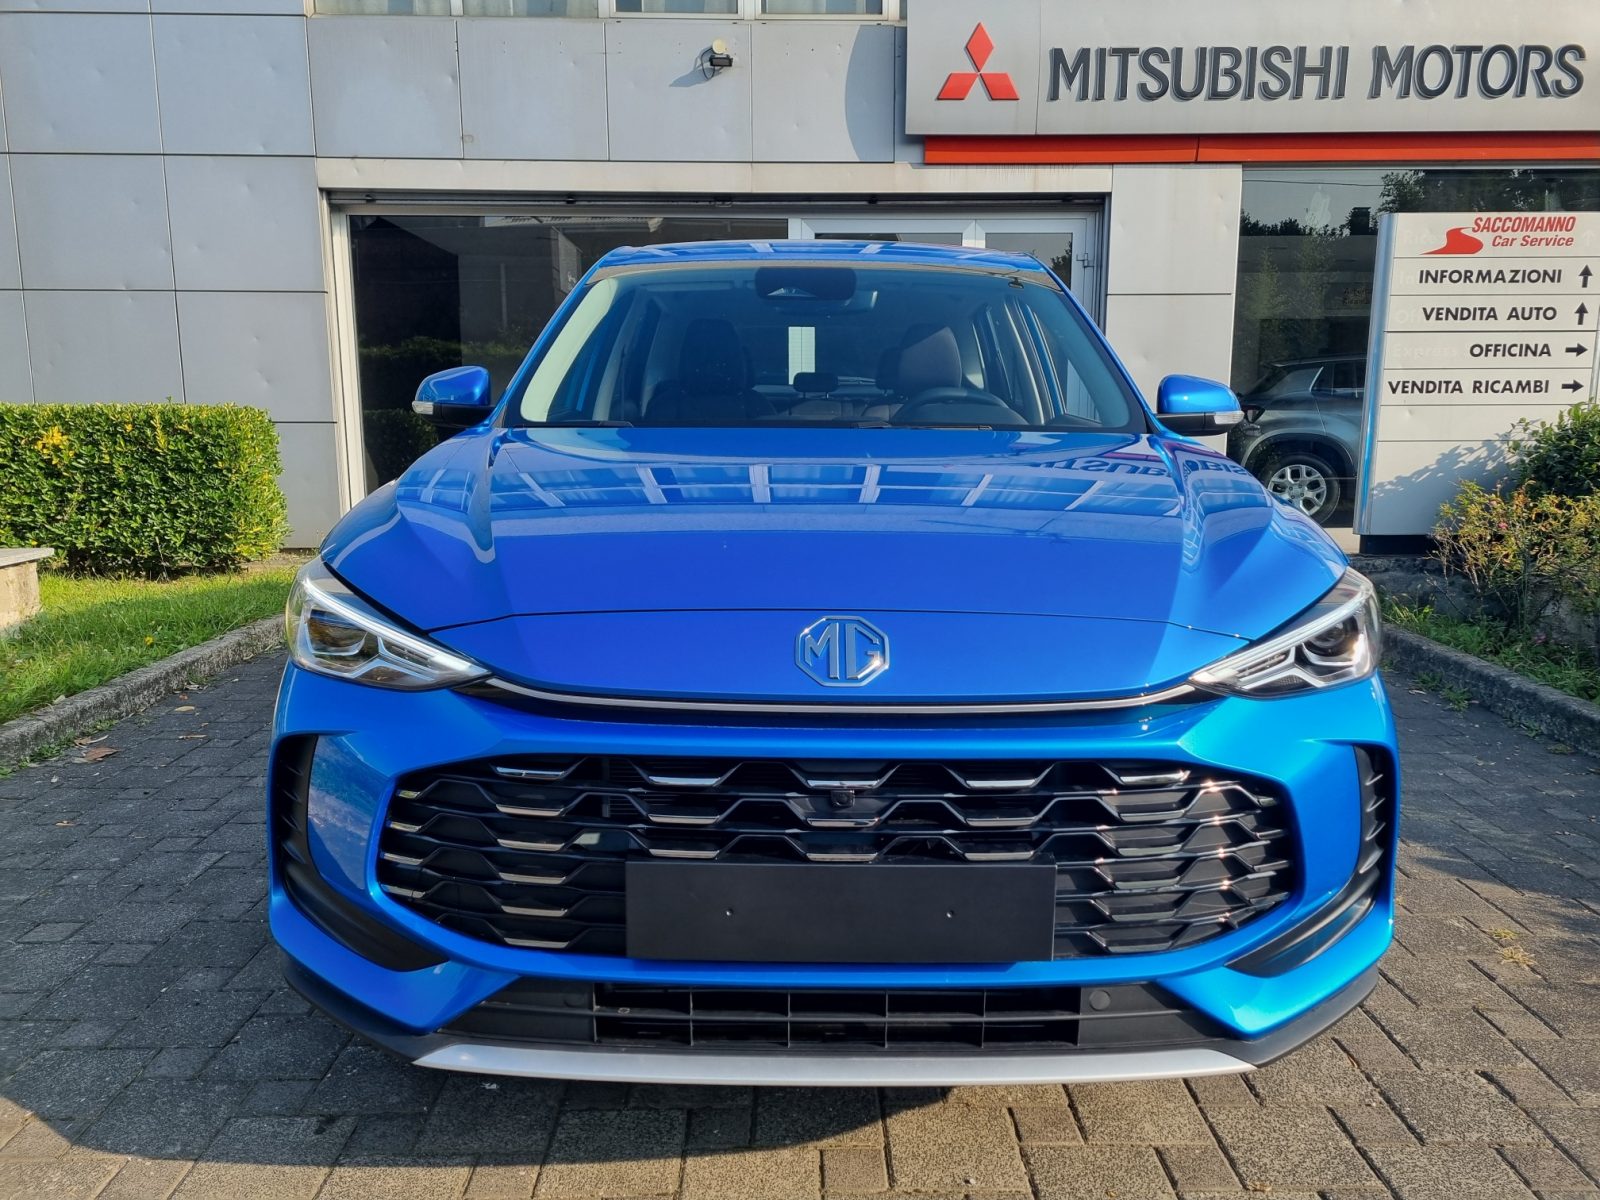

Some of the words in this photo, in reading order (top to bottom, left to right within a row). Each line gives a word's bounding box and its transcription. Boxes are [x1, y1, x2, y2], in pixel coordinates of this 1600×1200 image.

[1048, 45, 1350, 101] MITSUBISHI
[1370, 43, 1587, 100] MOTORS
[1472, 216, 1576, 233] SACCOMANNO
[1491, 235, 1517, 247] Car
[1520, 234, 1574, 247] Service
[1418, 269, 1562, 284] INFORMAZIONI
[1422, 307, 1498, 321] VENDITA
[1506, 307, 1557, 321] AUTO
[1469, 343, 1552, 357] OFFICINA
[1388, 380, 1463, 394] VENDITA
[1472, 379, 1550, 394] RICAMBI
[804, 621, 882, 679] MG
